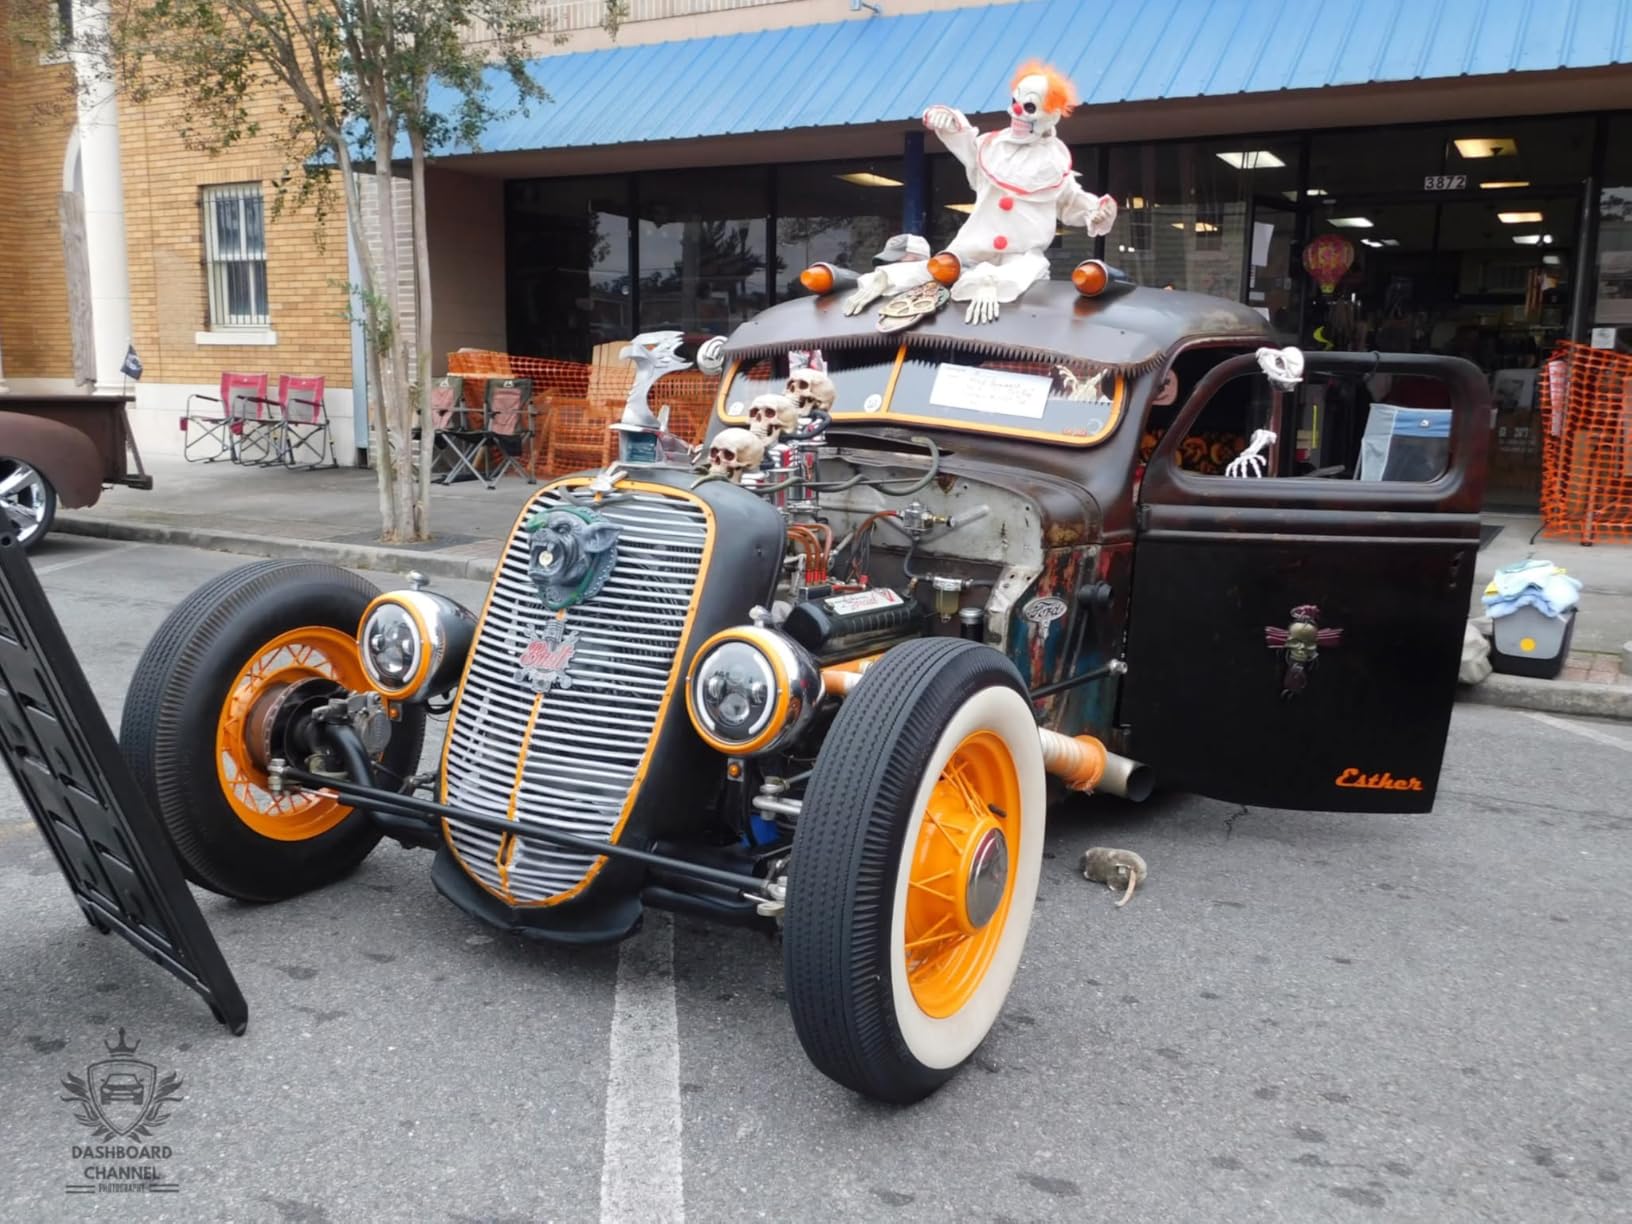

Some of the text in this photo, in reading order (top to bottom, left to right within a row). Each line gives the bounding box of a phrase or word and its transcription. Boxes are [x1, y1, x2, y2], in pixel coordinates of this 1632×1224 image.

[1425, 176, 1466, 190] 3872
[1025, 601, 1063, 619] Ford
[1335, 767, 1424, 791] Esther
